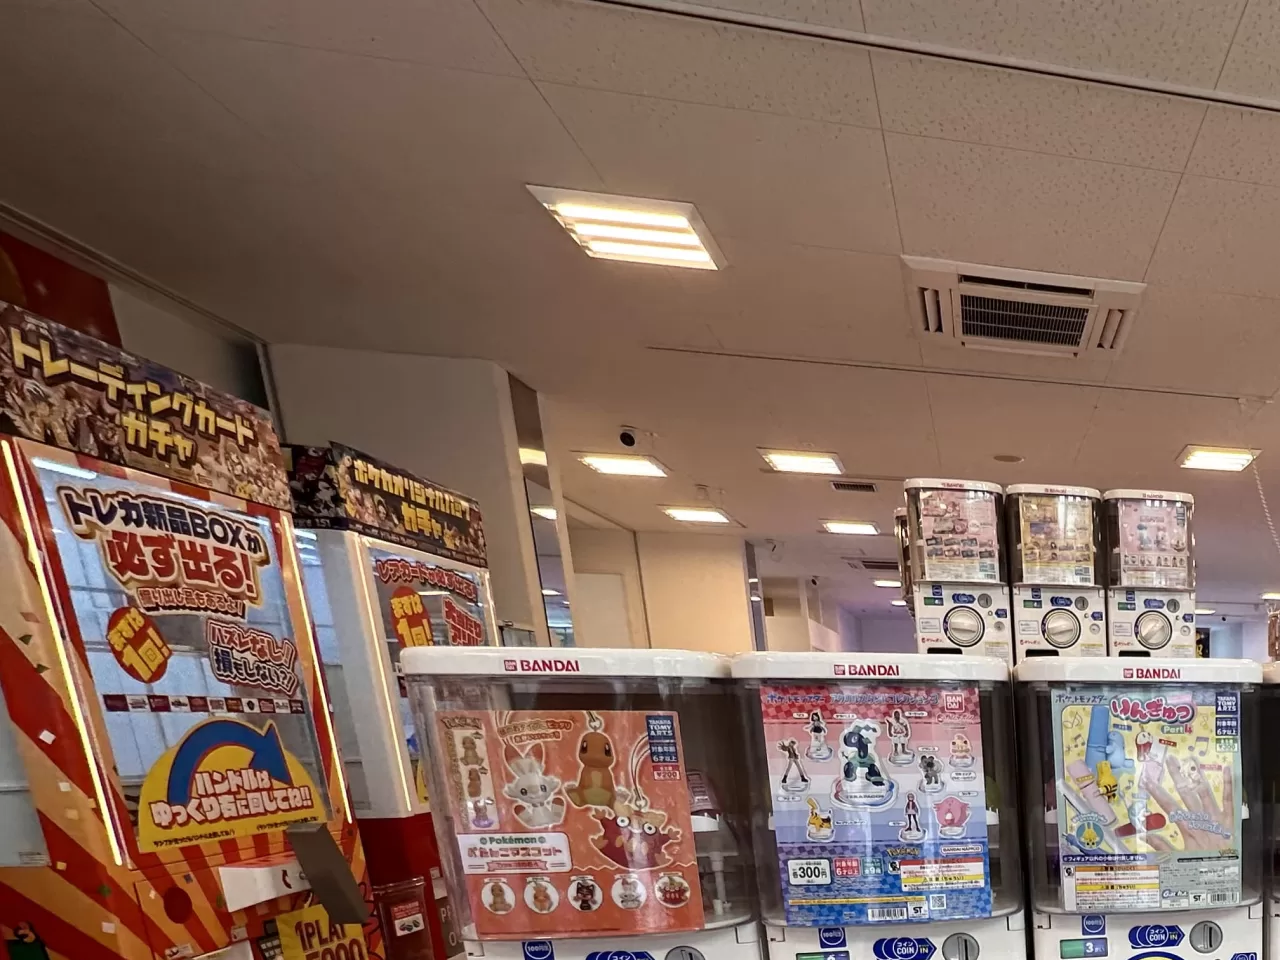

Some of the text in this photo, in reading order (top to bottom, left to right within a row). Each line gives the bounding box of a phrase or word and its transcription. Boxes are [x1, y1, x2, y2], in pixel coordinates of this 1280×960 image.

[11, 328, 255, 447] トレーディングカード
[122, 414, 195, 462] ガチャ
[66, 494, 261, 553] トレカ新品BOXが
[401, 503, 442, 539] ガチャ
[108, 608, 144, 651] まずは
[520, 660, 580, 672] BANDAI
[849, 665, 899, 676] BANDAI
[1136, 669, 1180, 679] BANDAI
[1055, 694, 1108, 703] ポケットモンスター
[196, 769, 271, 795] ハンドルは
[489, 836, 537, 845] Pokémon
[1150, 933, 1165, 941] COIN
[896, 946, 928, 954] COIN IN
